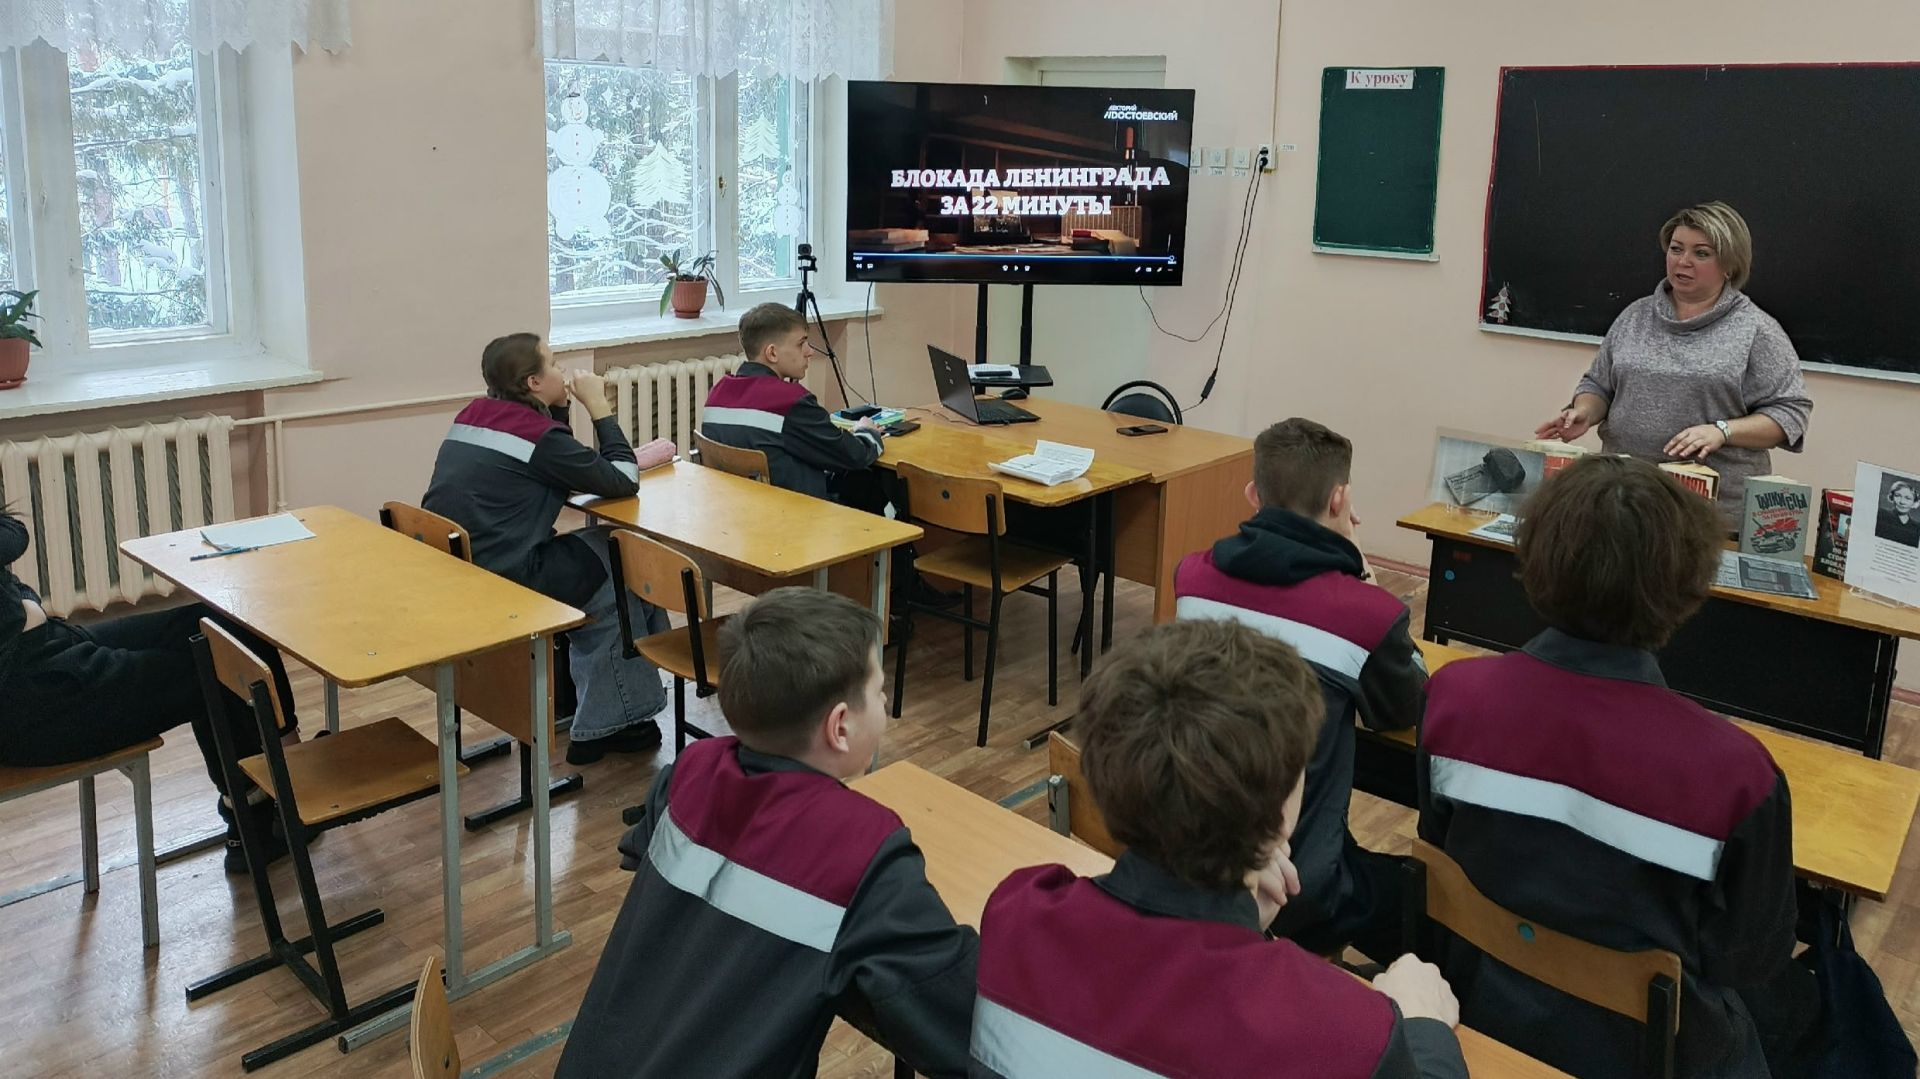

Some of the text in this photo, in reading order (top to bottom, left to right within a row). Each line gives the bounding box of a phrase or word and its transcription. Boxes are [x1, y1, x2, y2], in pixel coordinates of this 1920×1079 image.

[1351, 71, 1409, 87] К уроку
[890, 166, 1170, 191] БЛОКАДА ЛЕНИНГРАДА
[940, 195, 1112, 216] ЗА 22 МИНУТЫ
[1755, 491, 1808, 511] ТАНКИСТЫ
